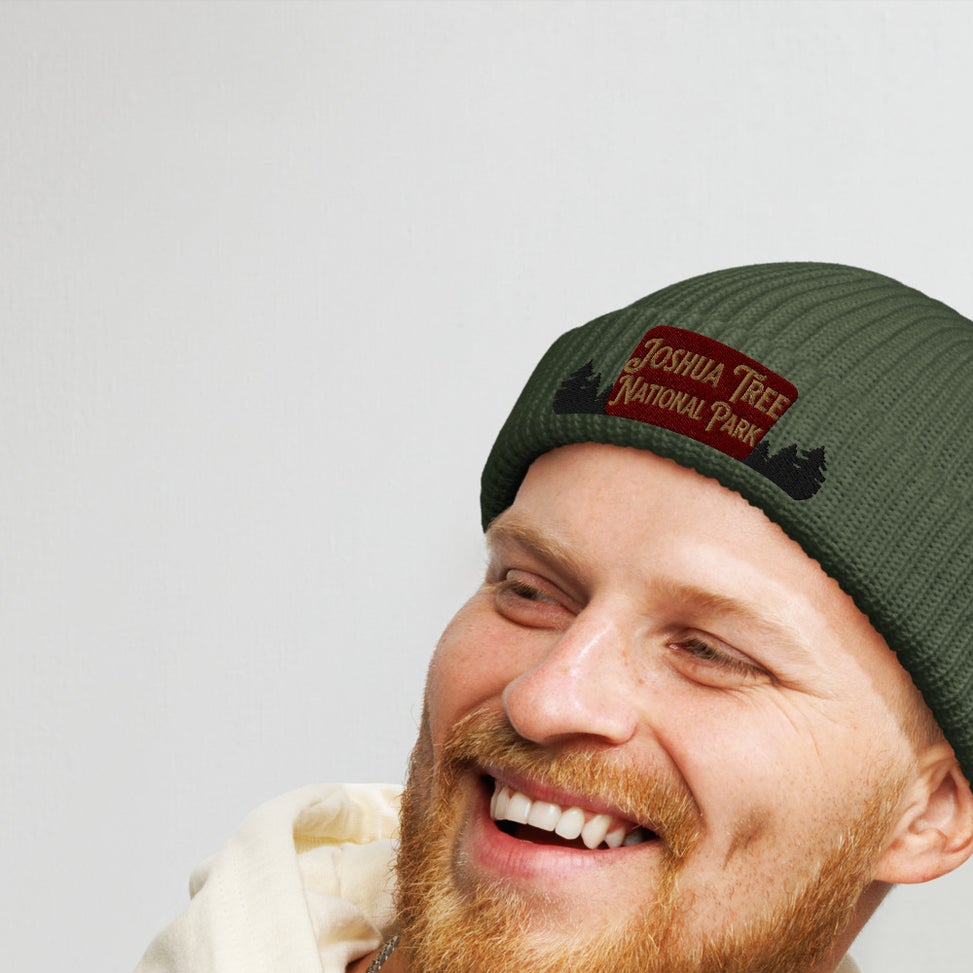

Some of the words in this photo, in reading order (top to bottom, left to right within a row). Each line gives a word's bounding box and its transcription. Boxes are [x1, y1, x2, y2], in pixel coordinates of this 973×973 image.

[608, 374, 706, 421] NATIONAL
[705, 400, 763, 448] PARK
[623, 337, 727, 389] JOSHUA
[729, 364, 791, 421] TREE
